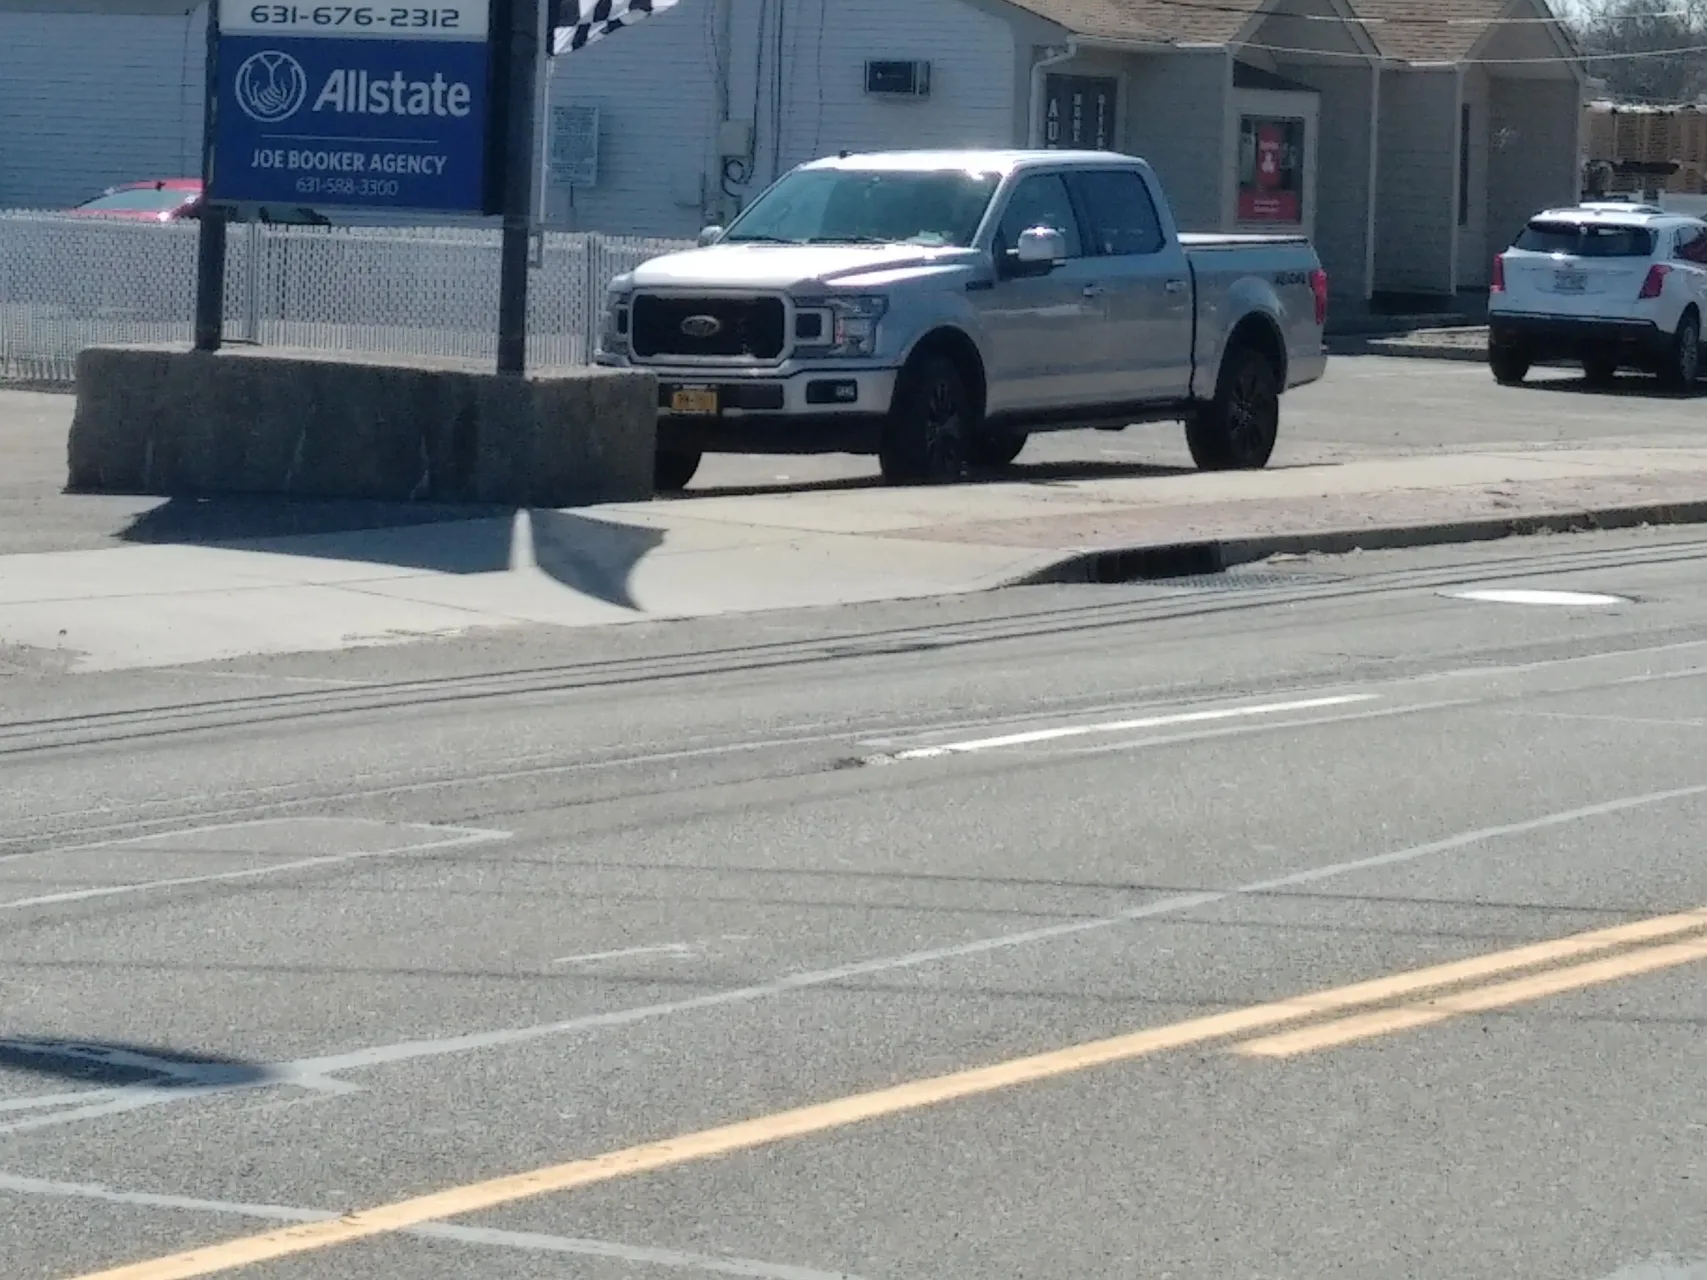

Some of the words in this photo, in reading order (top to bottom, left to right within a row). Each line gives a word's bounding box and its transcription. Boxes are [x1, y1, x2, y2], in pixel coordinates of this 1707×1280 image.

[250, 5, 460, 29] 631-676-2312
[313, 69, 472, 117] Allstate
[251, 149, 284, 169] JOE
[288, 150, 365, 172] BOOKER
[370, 153, 447, 175] AGENCY
